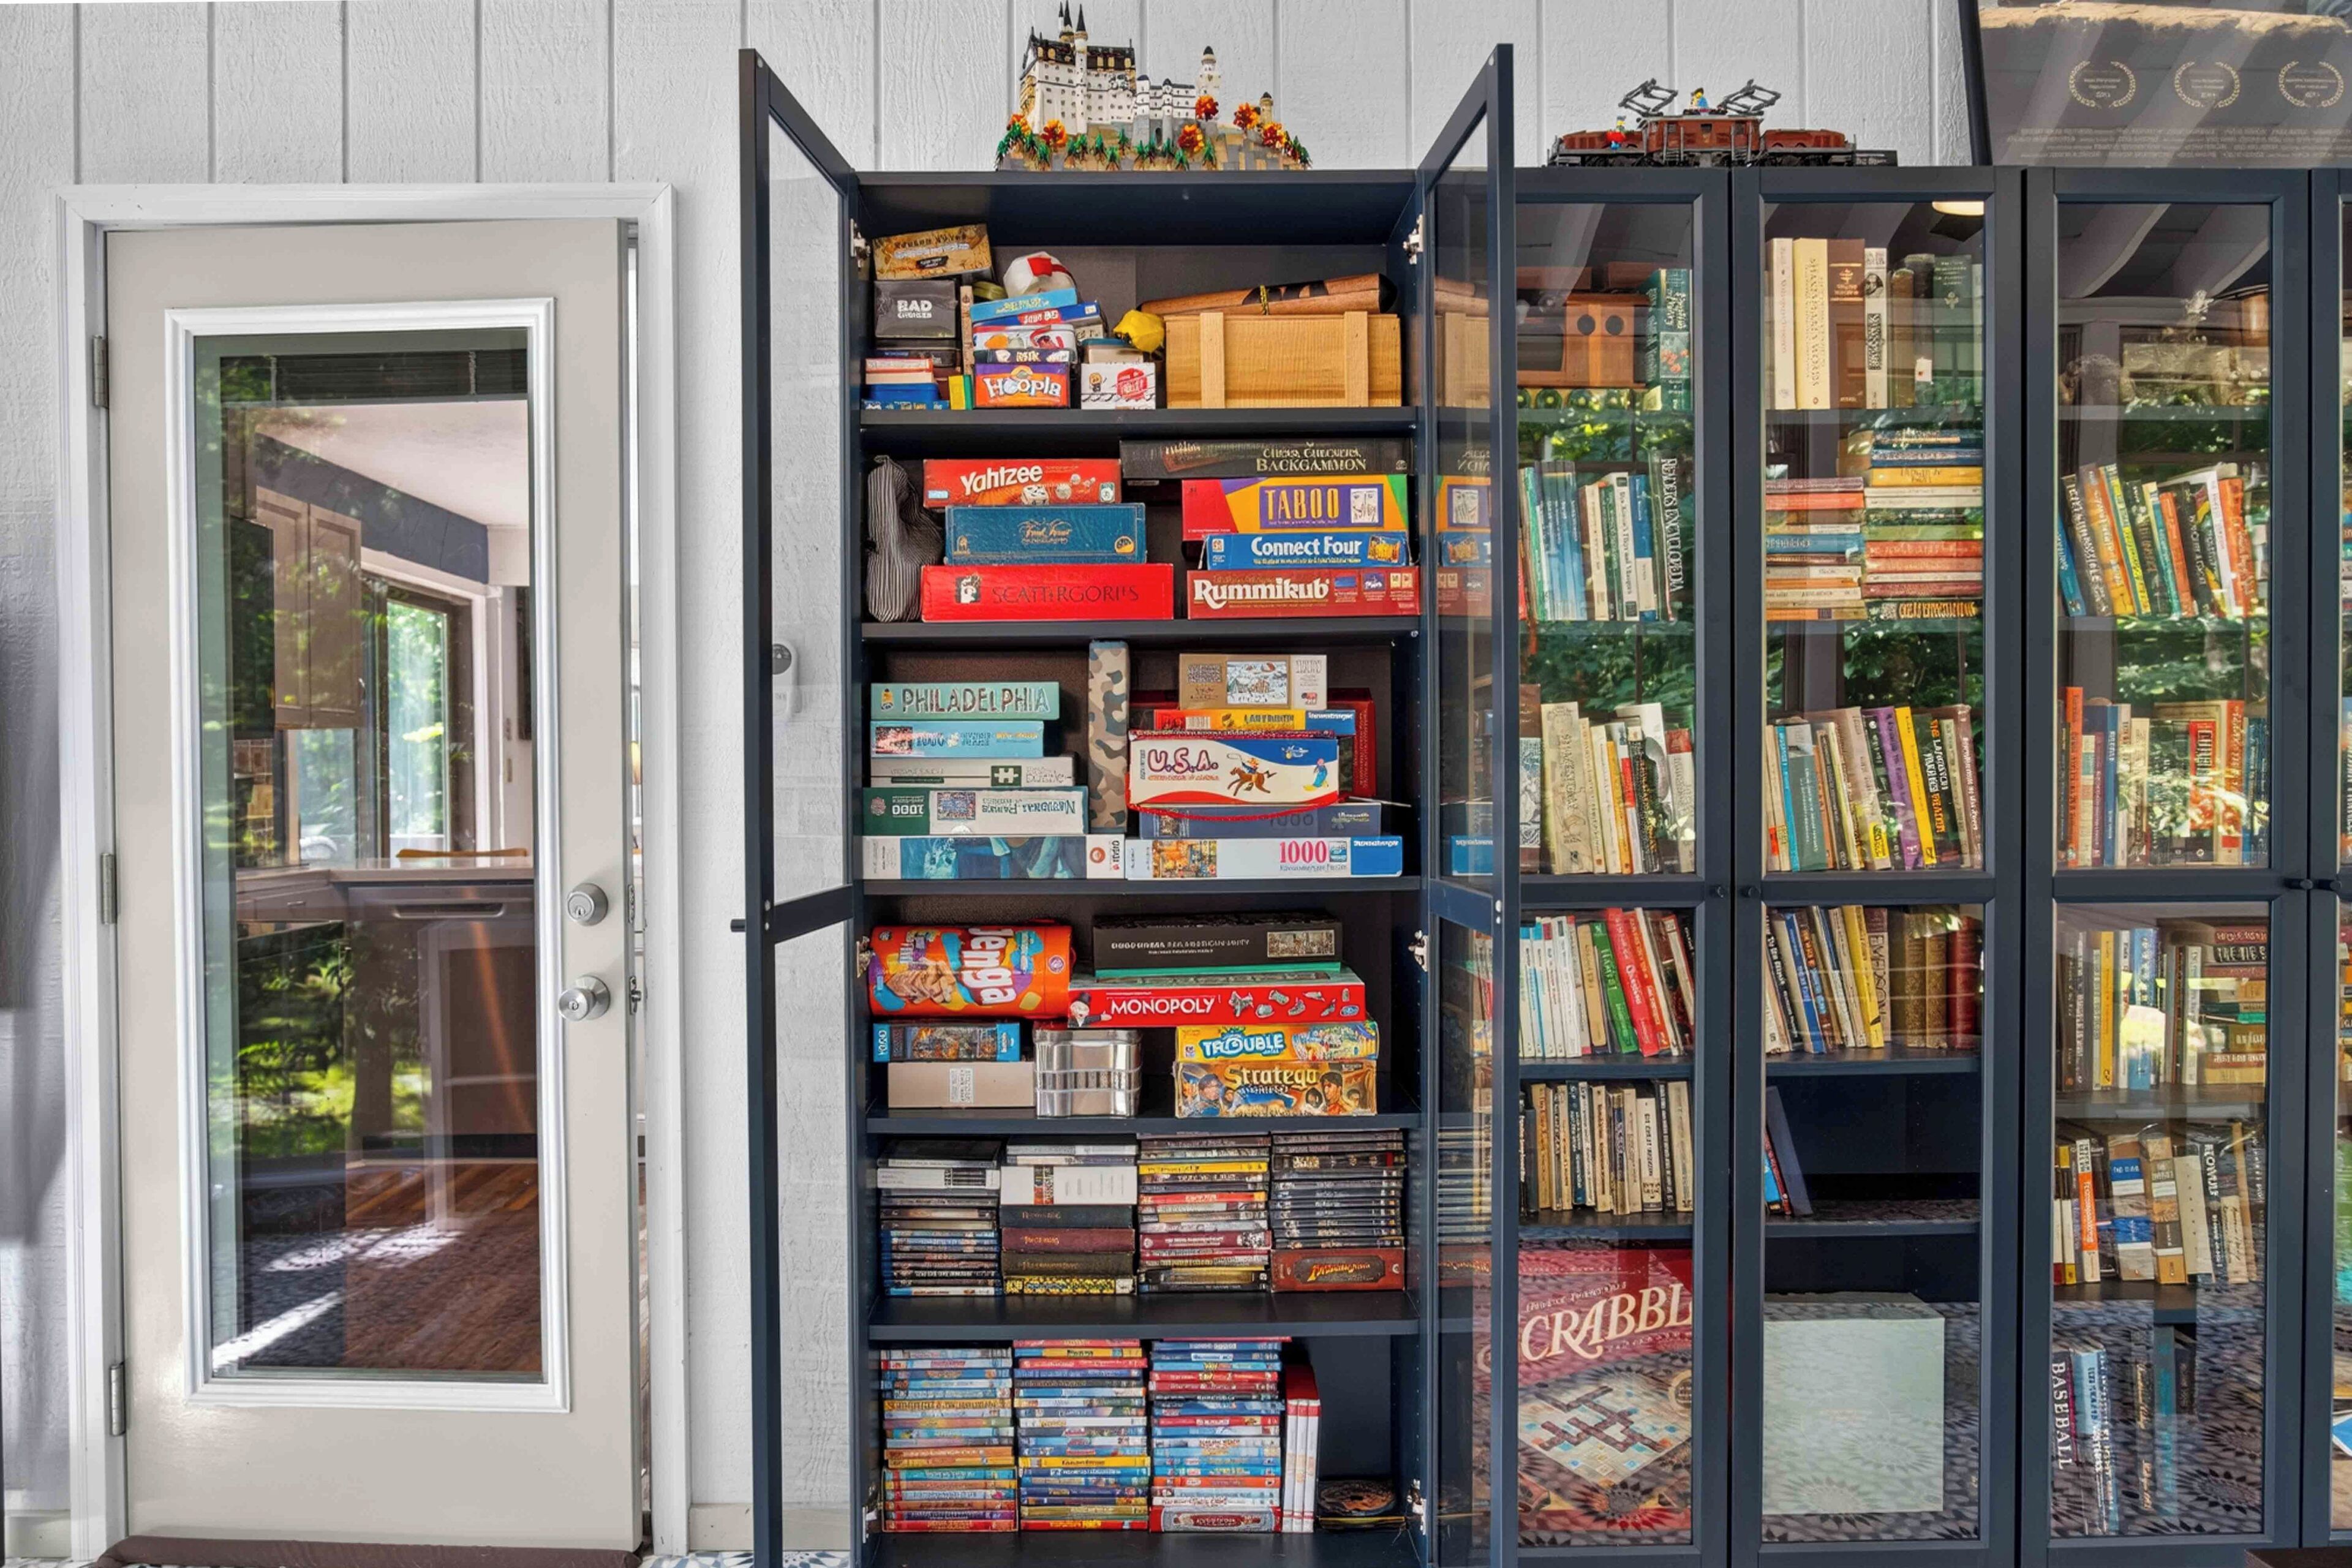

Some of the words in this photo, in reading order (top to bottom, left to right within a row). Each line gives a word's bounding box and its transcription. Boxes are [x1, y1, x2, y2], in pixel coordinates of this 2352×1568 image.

[896, 299, 932, 312] BAD
[982, 374, 1061, 399] Hoopla
[1256, 458, 1366, 472] BACKGAMMON
[960, 464, 1043, 495] Yahtzee
[1264, 488, 1340, 521] TABOO
[1251, 537, 1317, 556] Connect
[1323, 535, 1362, 555] Four
[1193, 579, 1330, 609] Rummikub
[902, 687, 1050, 713] PHILADELPHIA
[1280, 840, 1327, 863] 1000
[962, 927, 1017, 1005] Jenga
[1111, 998, 1215, 1015] MONOPOLY
[1203, 1032, 1285, 1058] TROUBLE
[1224, 1066, 1318, 1090] Stratego
[2052, 1361, 2073, 1470] BASEBALL
